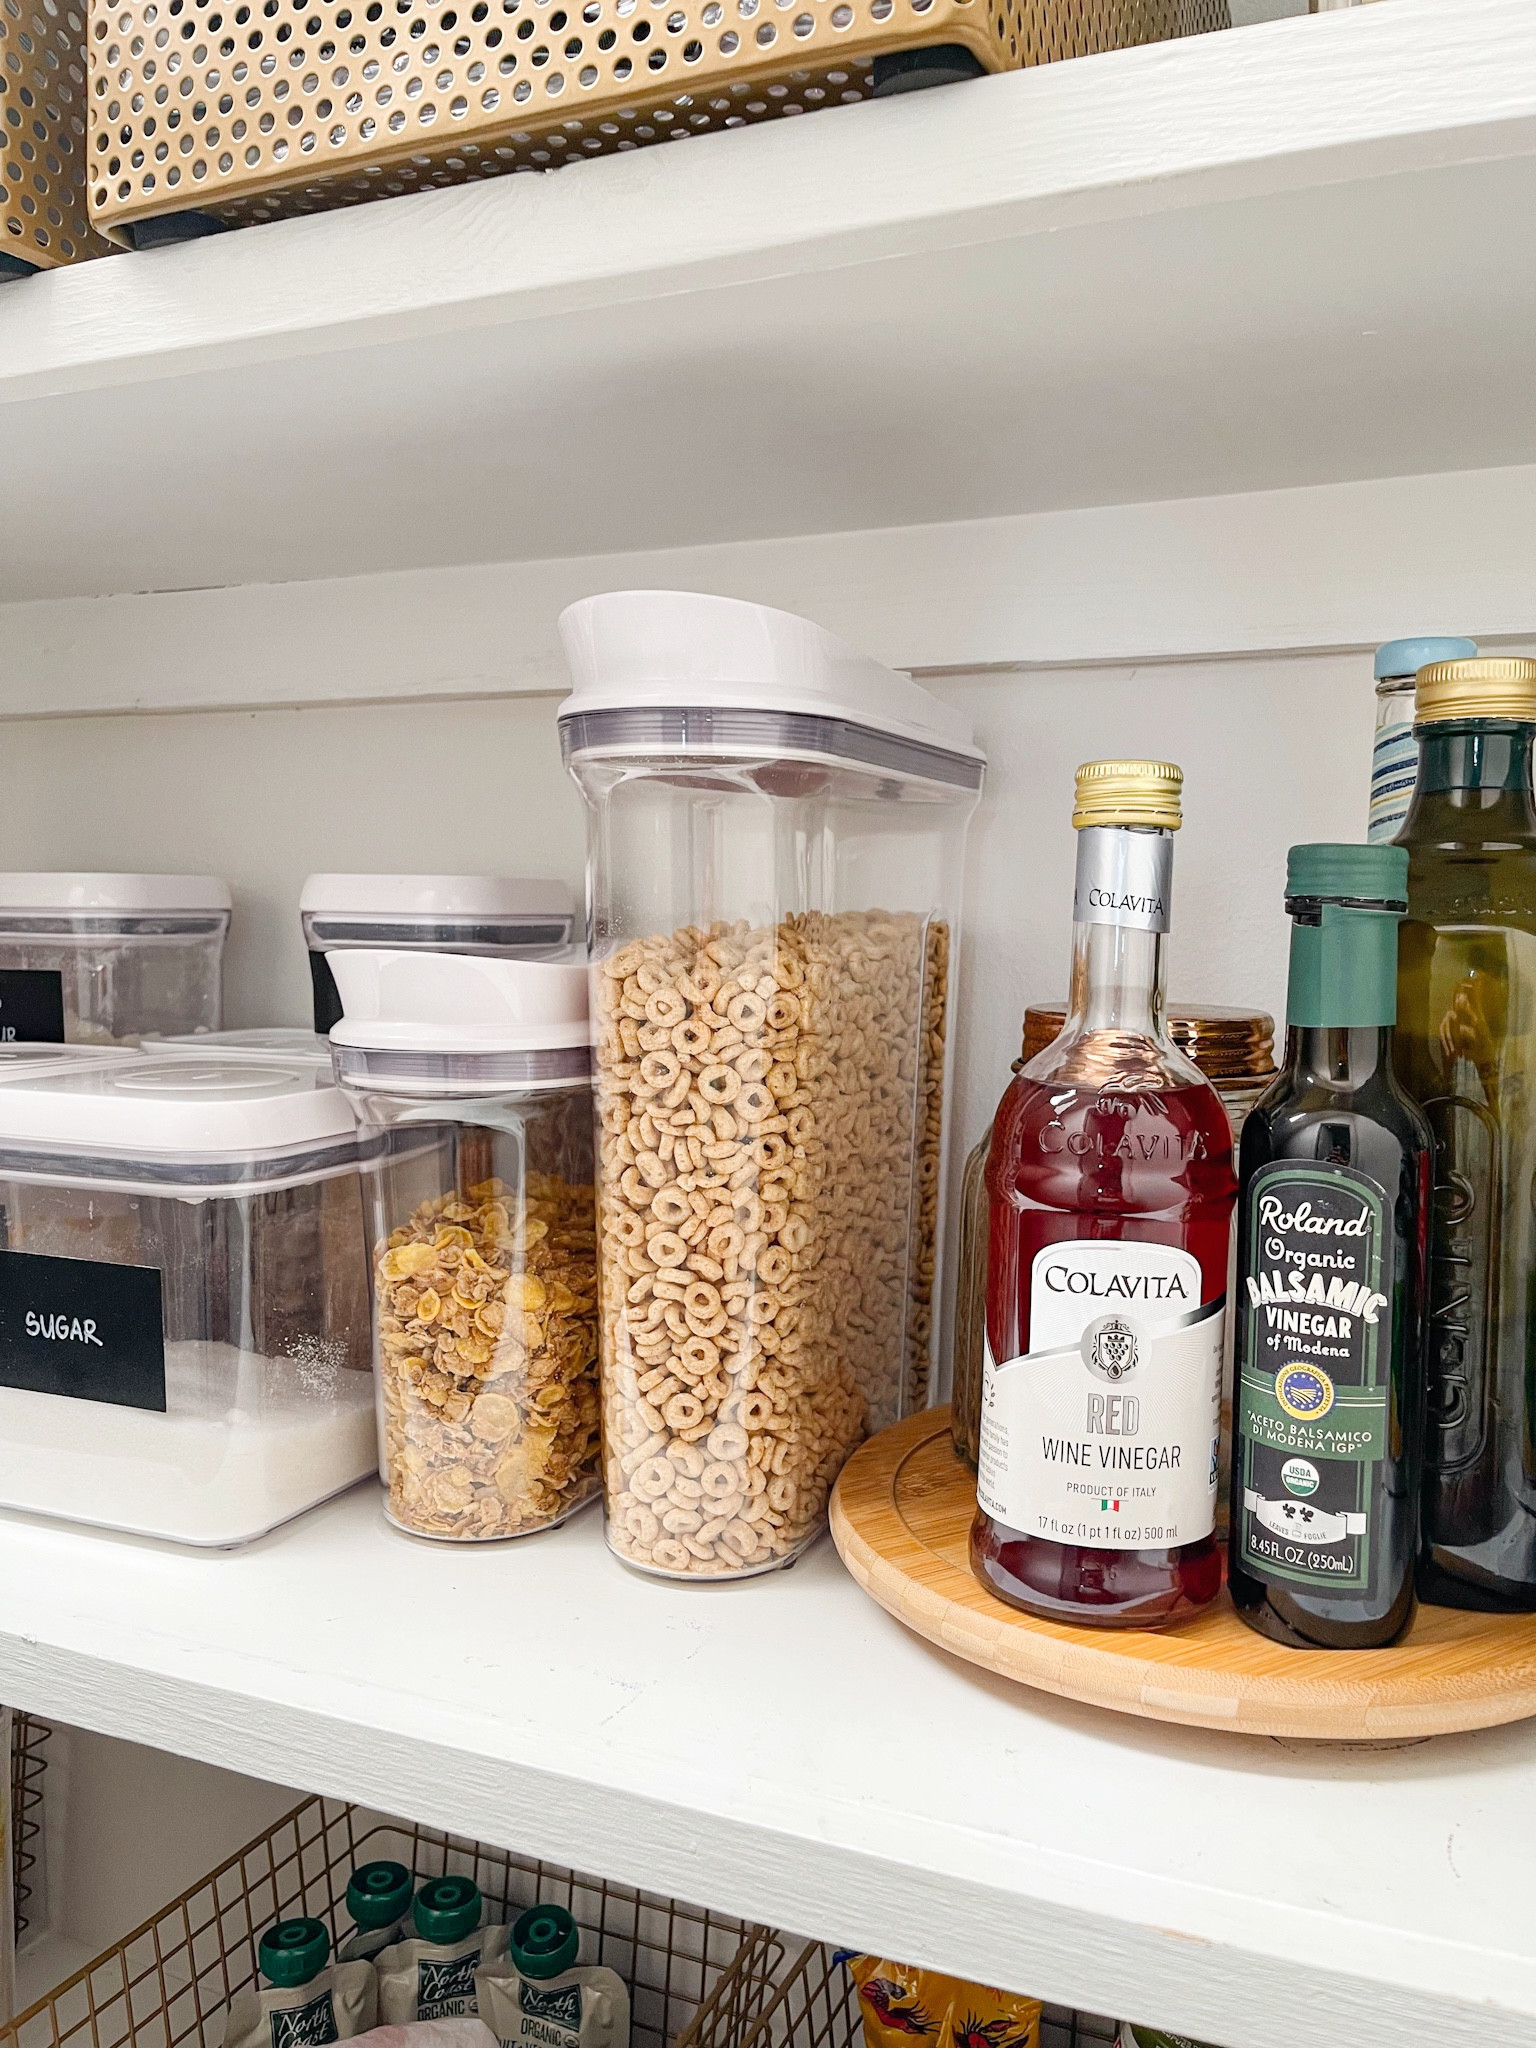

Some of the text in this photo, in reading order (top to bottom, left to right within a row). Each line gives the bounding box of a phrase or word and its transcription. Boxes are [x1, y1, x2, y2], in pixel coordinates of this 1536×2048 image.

[1089, 888, 1164, 916] COLAVITA
[1259, 1195, 1369, 1237] Roland
[1265, 1236, 1356, 1271] Organic
[1045, 1265, 1187, 1299] COLAVITA
[1246, 1269, 1388, 1324] BALSAMIC
[25, 1311, 104, 1346] SUGAR
[1265, 1306, 1352, 1339] VINEGAR
[1266, 1333, 1351, 1358] of Modena
[1086, 1393, 1140, 1436] RED
[1253, 1424, 1263, 1436] DI
[1267, 1431, 1325, 1451] MODENA
[1290, 1424, 1372, 1442] BALSAMICO
[1042, 1436, 1181, 1470] WINE VINEGAR
[1289, 1465, 1312, 1478] USDA
[1066, 1482, 1157, 1498] PRODUCT OF ITALY
[1038, 1516, 1178, 1540] 17 fl oz (1 pt 1 fl oz) 500 ml
[1269, 1520, 1327, 1540] LEAVES FOGLIE
[424, 1960, 477, 1986] North
[418, 1999, 465, 2021] ORGANIC
[523, 1987, 577, 2011] North
[278, 2000, 330, 2037] North
[521, 2018, 562, 2047] ORGANIC
